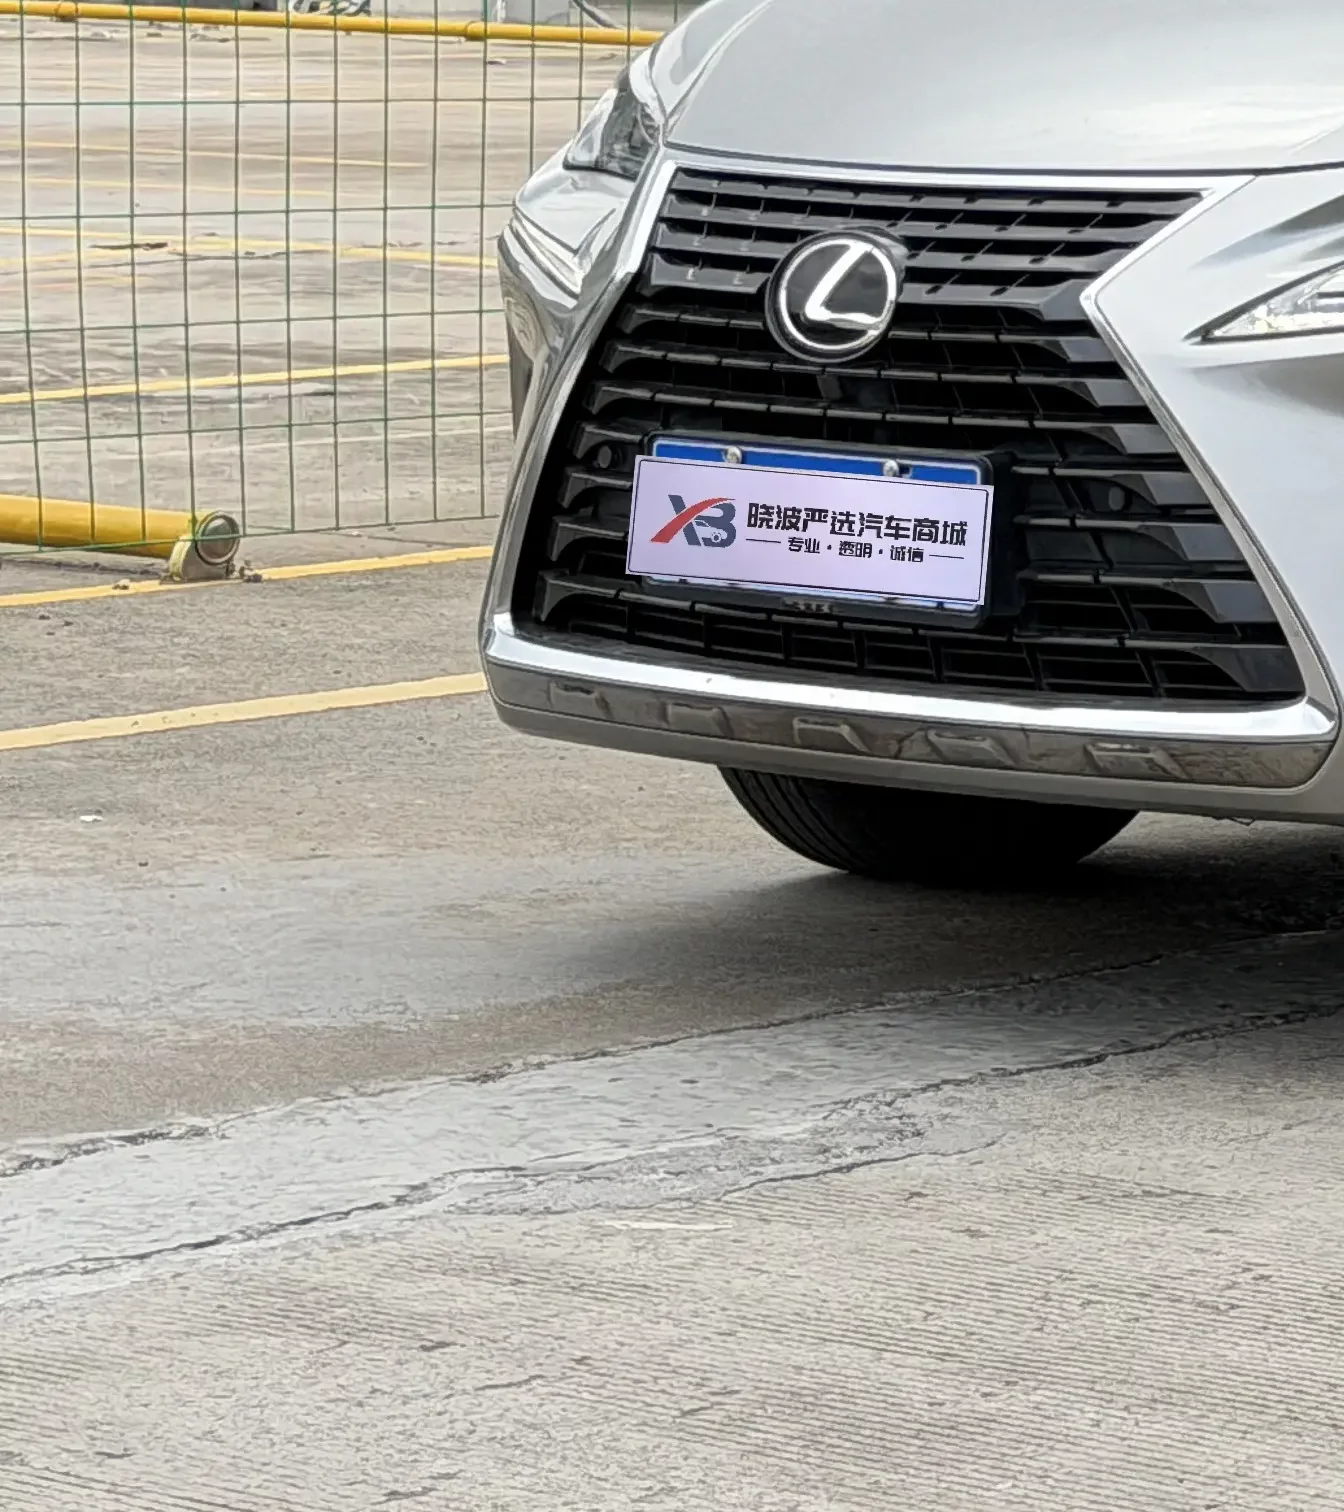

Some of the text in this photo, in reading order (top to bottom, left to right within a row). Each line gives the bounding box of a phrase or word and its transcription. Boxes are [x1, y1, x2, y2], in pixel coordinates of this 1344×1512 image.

[747, 502, 968, 546] 晓波严选汽车商城
